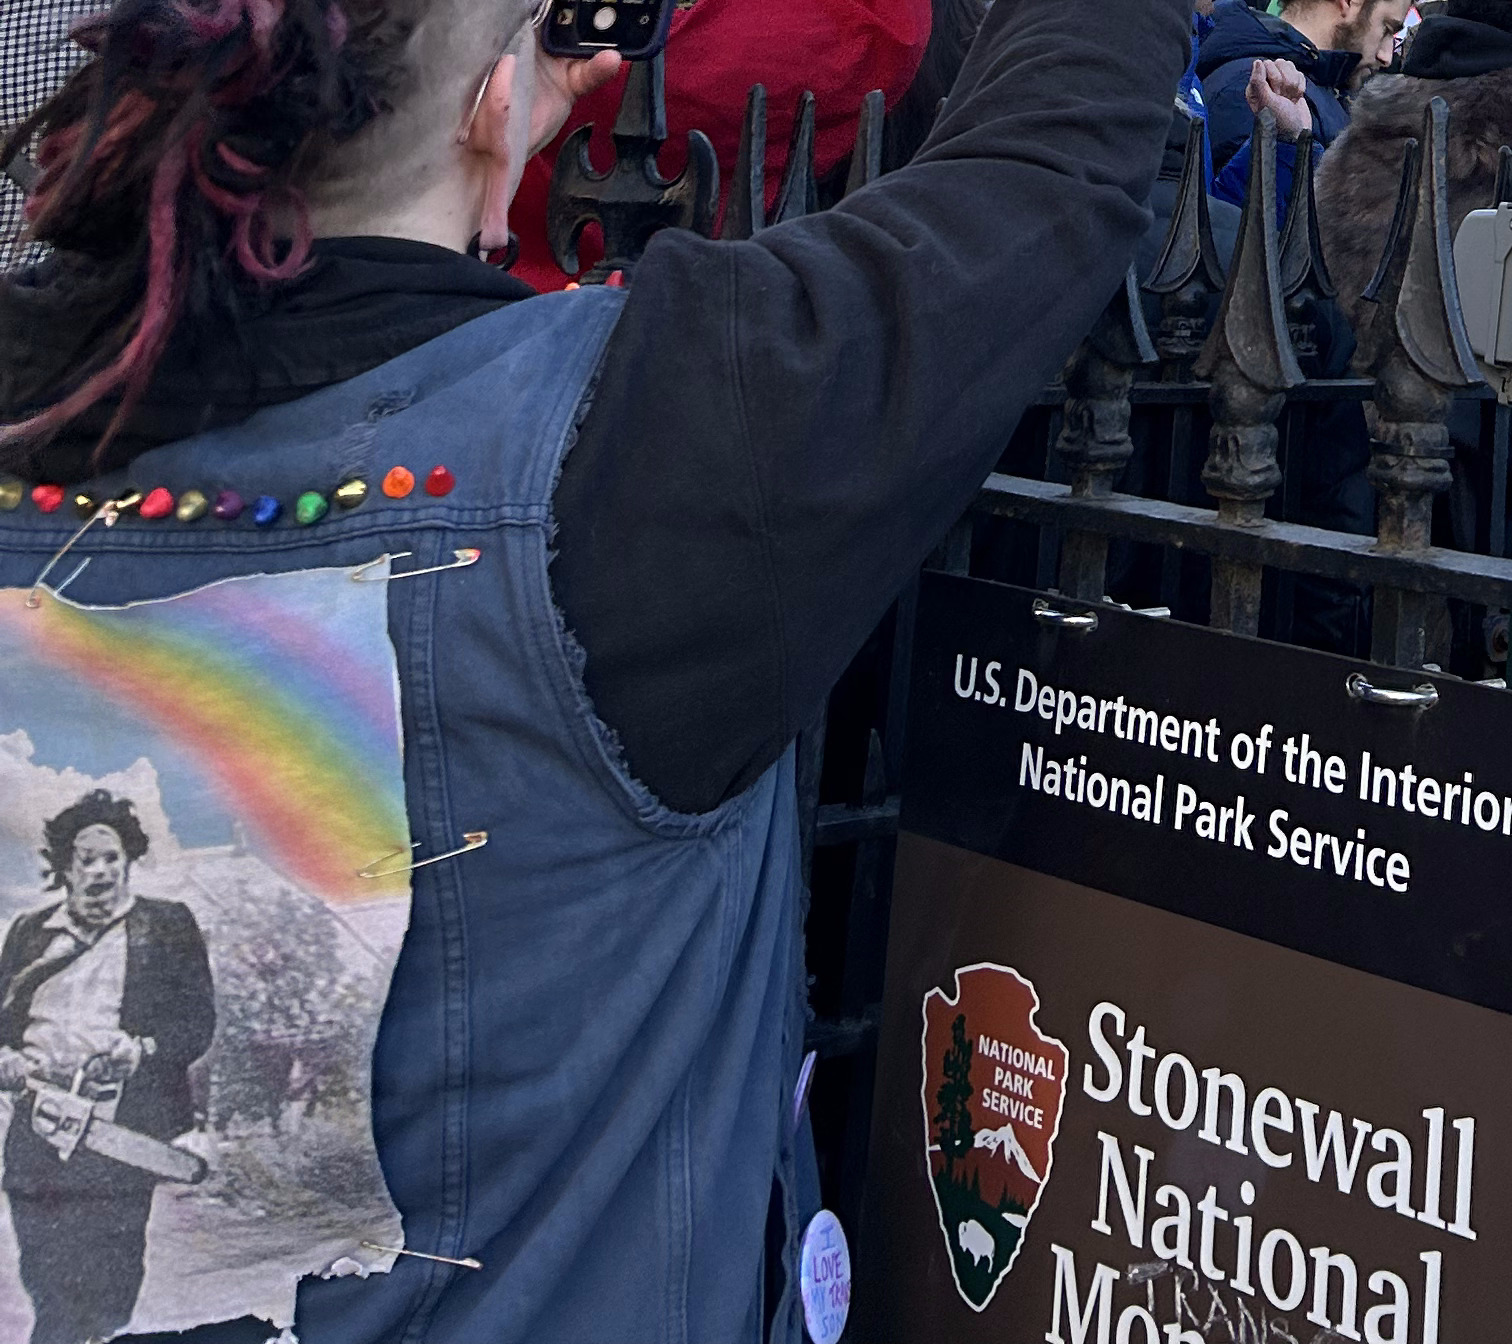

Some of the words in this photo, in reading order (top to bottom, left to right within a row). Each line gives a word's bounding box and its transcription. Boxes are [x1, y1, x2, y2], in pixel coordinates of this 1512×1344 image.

[954, 653, 1006, 707] U.S.
[1014, 668, 1221, 763] Department
[1231, 723, 1273, 774] of
[1282, 734, 1347, 794] the
[1019, 742, 1164, 824] National
[1174, 783, 1256, 851] Park
[1267, 809, 1411, 893] Service
[978, 1034, 1055, 1081] NATIONAL
[994, 1066, 1034, 1099] PARK
[982, 1088, 1044, 1129] SERVICE
[1083, 1002, 1478, 1241] Stonewall
[812, 1250, 843, 1284] LOVE
[1091, 1130, 1443, 1344] National
